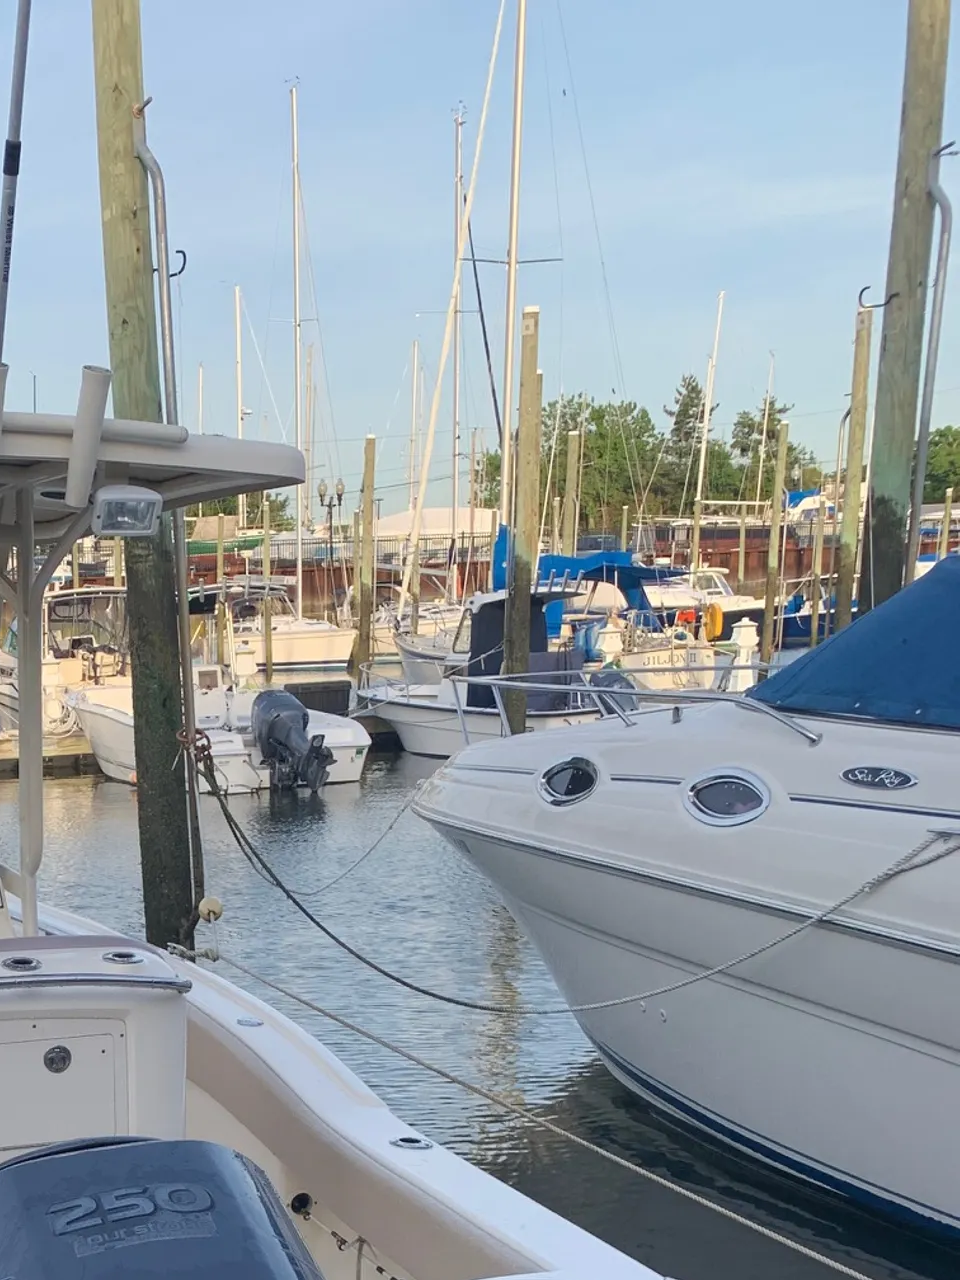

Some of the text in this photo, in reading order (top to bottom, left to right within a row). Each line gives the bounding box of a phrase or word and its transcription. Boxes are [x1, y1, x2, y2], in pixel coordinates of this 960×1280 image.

[849, 769, 904, 787] Sea Ray
[45, 1183, 215, 1236] 250
